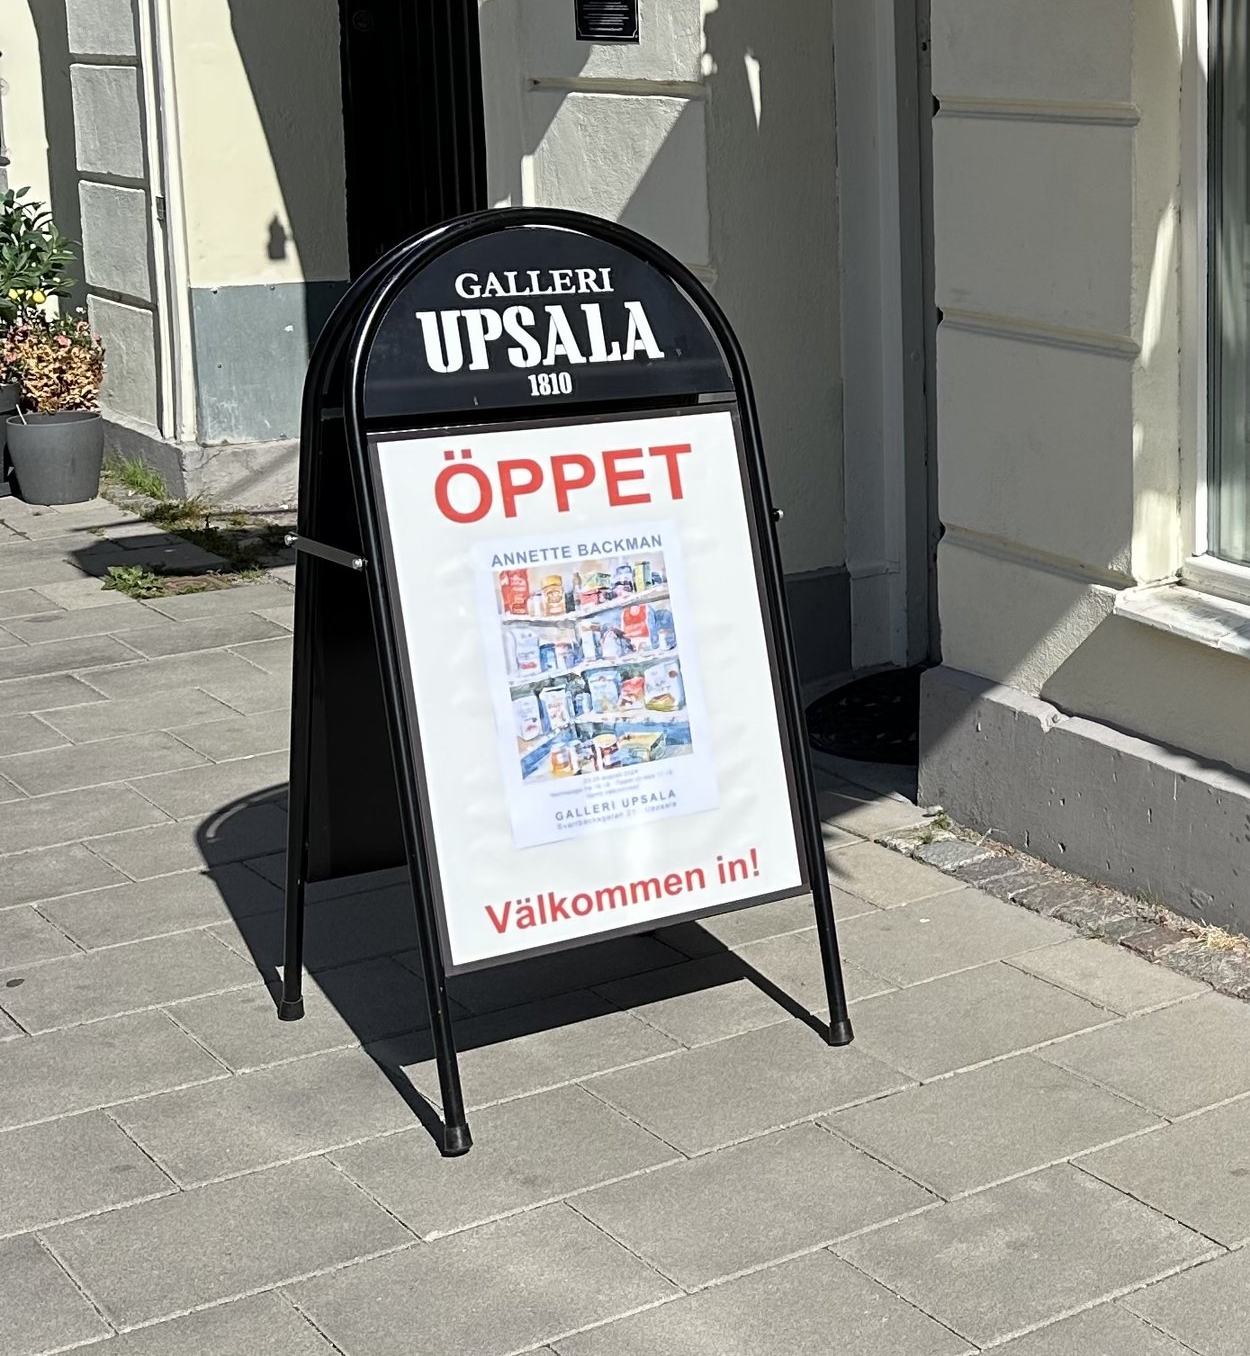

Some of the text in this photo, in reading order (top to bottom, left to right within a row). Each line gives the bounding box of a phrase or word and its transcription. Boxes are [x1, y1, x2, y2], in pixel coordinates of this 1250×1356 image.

[454, 267, 614, 299] GALLERI
[415, 300, 665, 373] UPSALA
[527, 371, 574, 396] 1810
[434, 443, 692, 524] ÖPPET
[490, 534, 662, 567] ANNETTE BACKMAN
[554, 801, 616, 822] GALLERI
[621, 789, 677, 809] UPSALA
[484, 848, 760, 934] Välkommen in!
